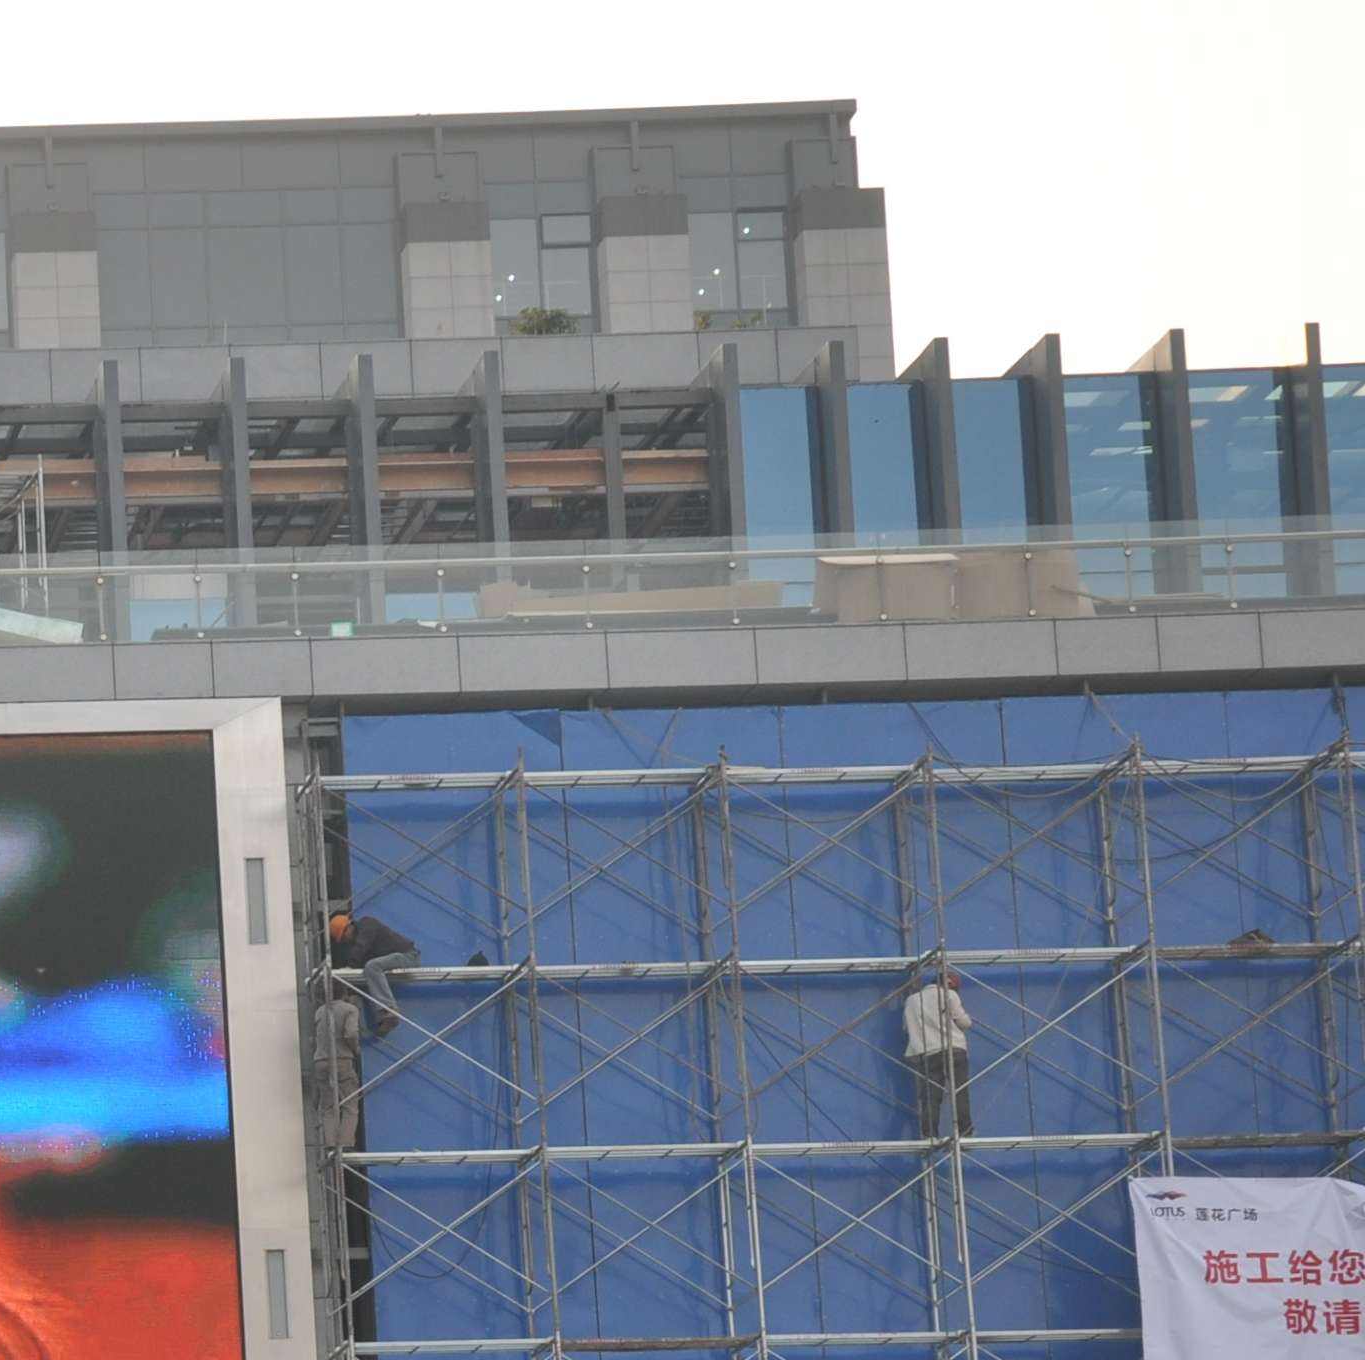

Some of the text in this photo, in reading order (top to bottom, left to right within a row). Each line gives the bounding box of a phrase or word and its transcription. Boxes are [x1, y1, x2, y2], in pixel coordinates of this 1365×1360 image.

[1195, 1207, 1259, 1222] 莲花广场
[1202, 1249, 1365, 1286] 施工给您
[1283, 1298, 1362, 1336] 敬请
